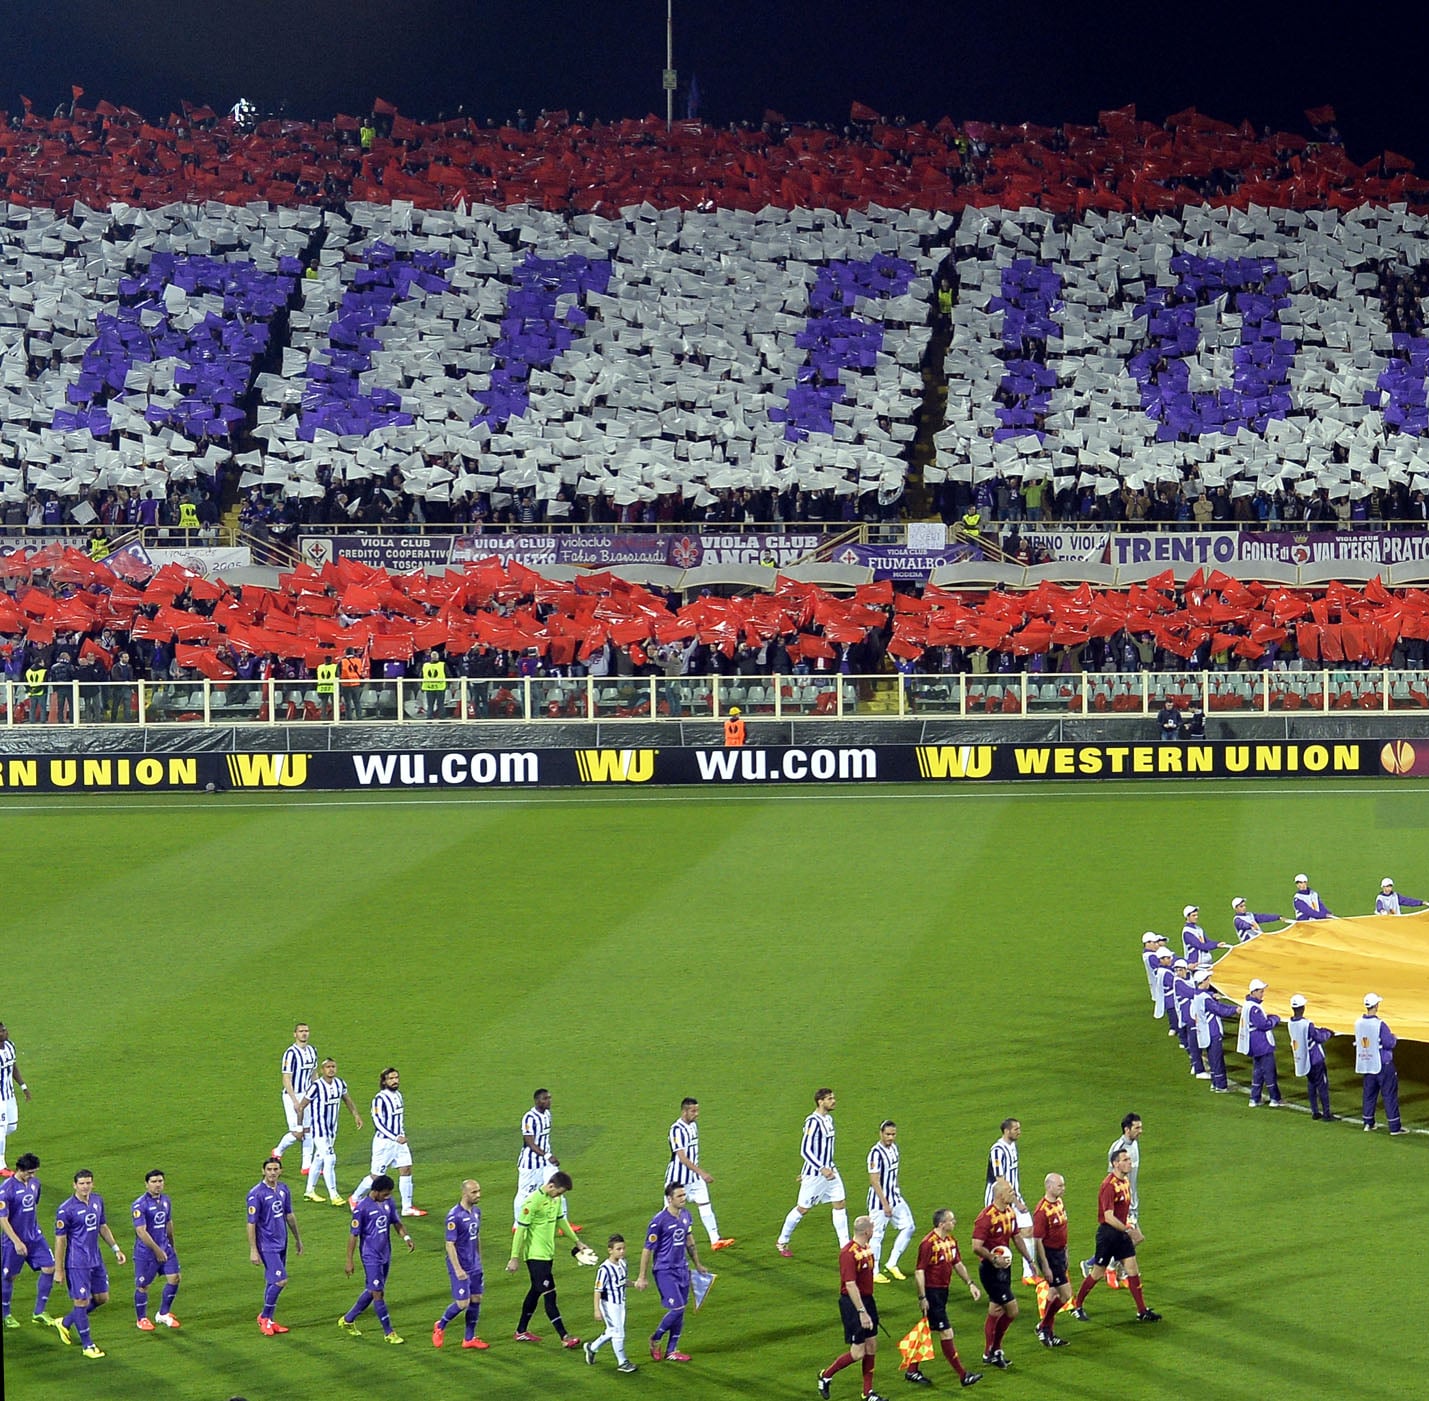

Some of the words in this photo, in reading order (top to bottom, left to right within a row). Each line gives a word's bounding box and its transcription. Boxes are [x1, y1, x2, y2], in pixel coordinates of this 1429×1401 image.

[361, 539, 394, 547] VIOLA
[401, 539, 431, 547] CLUB
[475, 539, 515, 548] VIOLA
[520, 539, 556, 548] CLUB
[561, 537, 612, 547] violaclub
[701, 537, 760, 548] VIOLA
[766, 537, 818, 548] CLUB
[1114, 537, 1235, 563] TRENTO
[1242, 542, 1279, 561] COLLE
[1280, 548, 1289, 560] di
[1313, 543, 1338, 562] VAL
[339, 550, 380, 558] CREDITO
[359, 561, 385, 569] ELLA
[868, 557, 947, 570] FIUMALBO
[353, 752, 539, 786] wu.com
[585, 750, 654, 781] WU
[696, 748, 877, 780] wu.com
[924, 746, 992, 777] WU
[1015, 744, 1213, 772] WESTERN
[1225, 743, 1360, 771] UNION
[0, 760, 37, 786] N
[51, 758, 197, 786] UNION
[236, 754, 307, 786] WU
